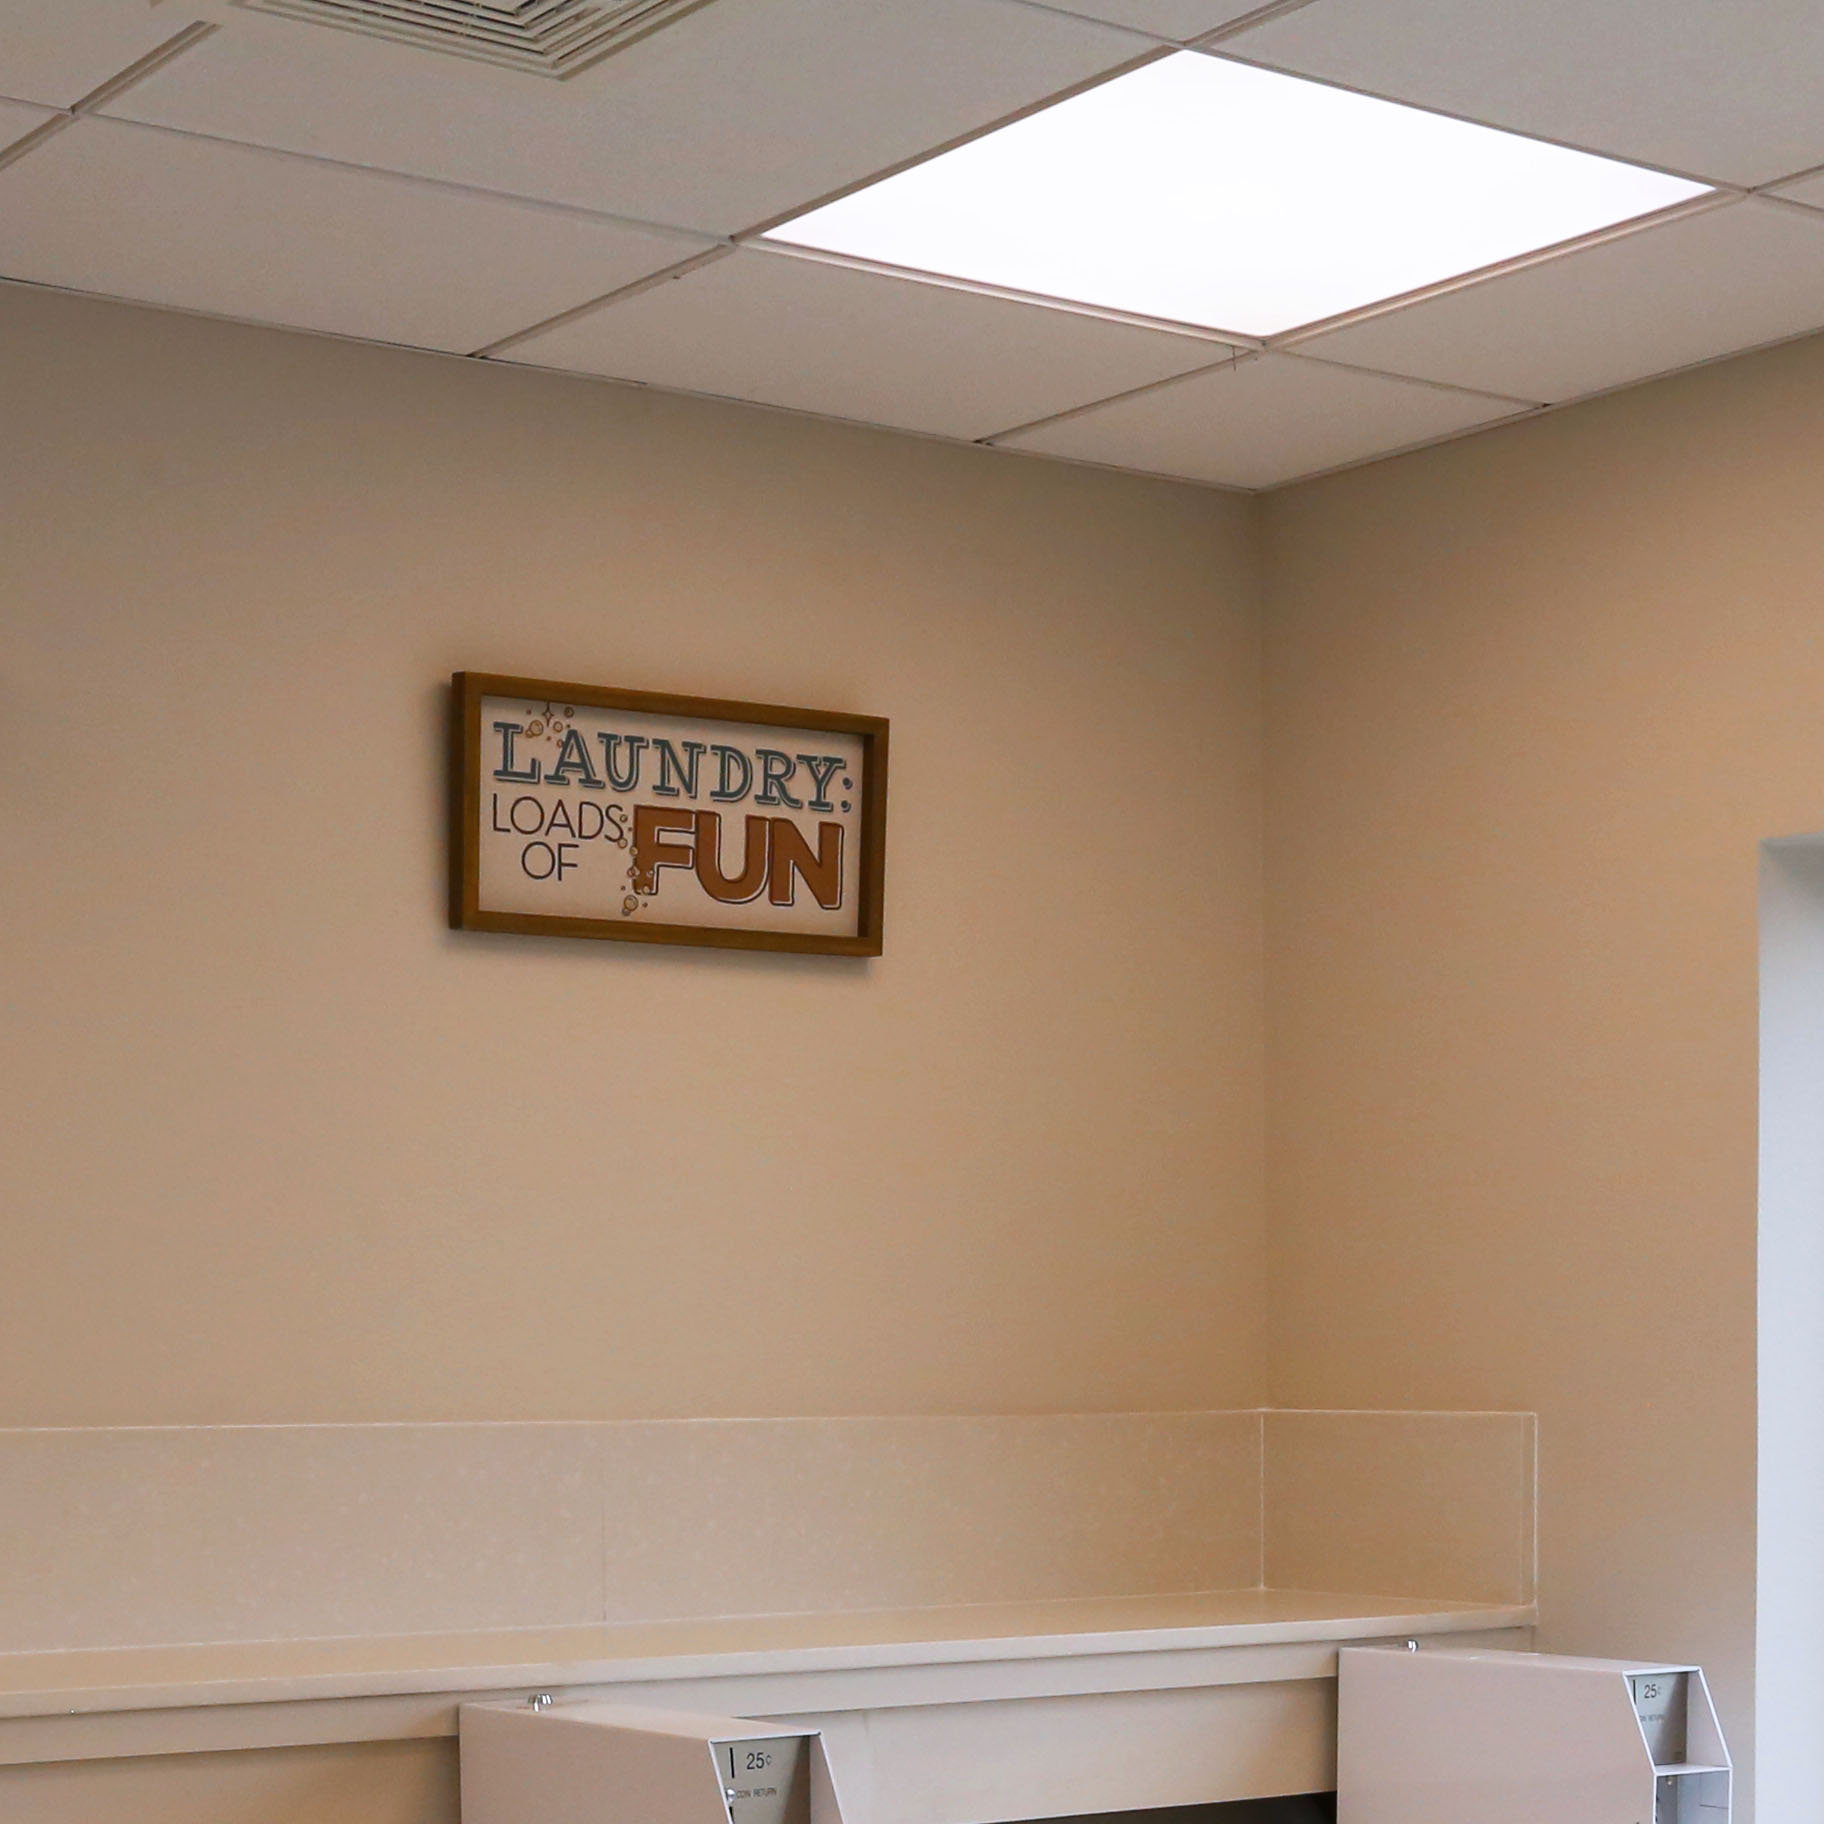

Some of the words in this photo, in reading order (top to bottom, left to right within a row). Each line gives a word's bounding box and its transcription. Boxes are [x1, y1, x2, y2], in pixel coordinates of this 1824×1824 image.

[492, 721, 854, 812] LAUNDRY:
[492, 793, 624, 843] LOADS
[521, 841, 579, 882] OF
[632, 803, 844, 910] FUN
